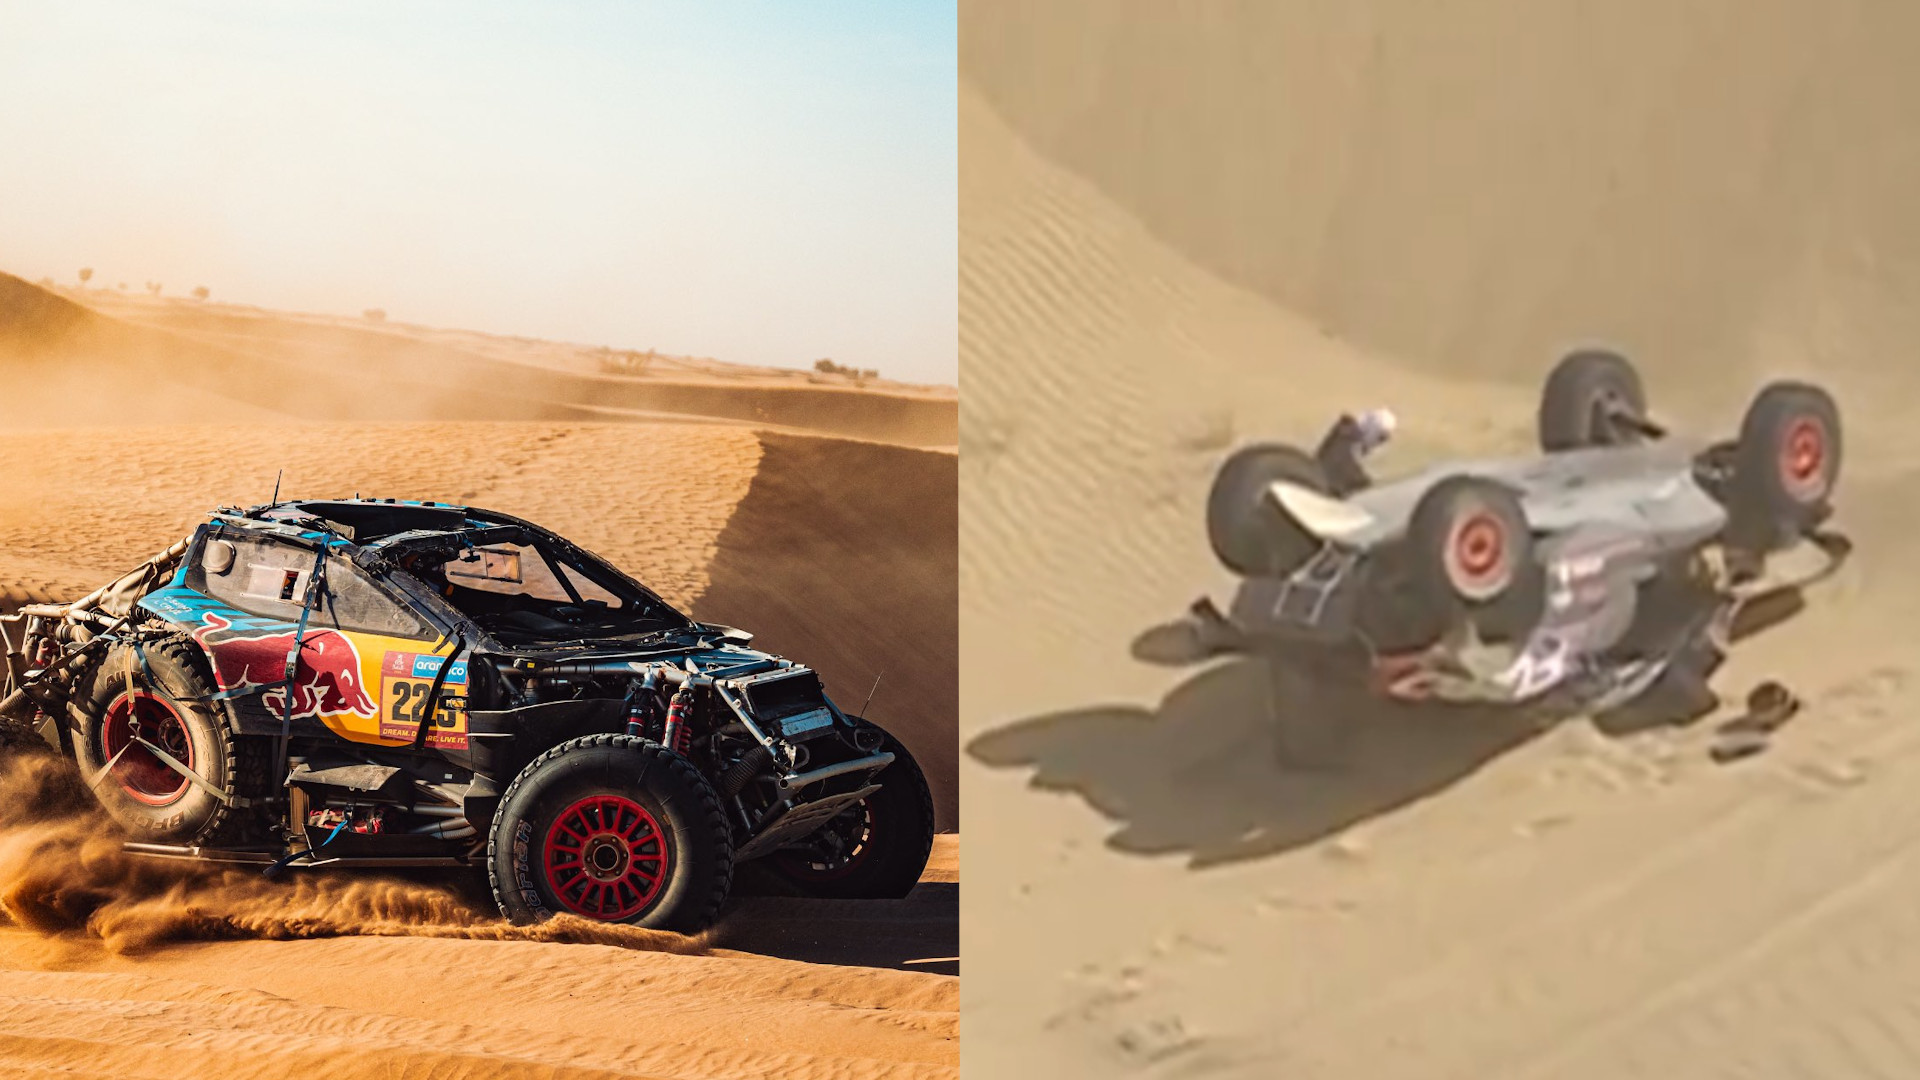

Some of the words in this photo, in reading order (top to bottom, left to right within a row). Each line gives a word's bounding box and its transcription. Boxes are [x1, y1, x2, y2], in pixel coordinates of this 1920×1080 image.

[392, 681, 456, 728] 225
[382, 728, 410, 737] DREAM.
[411, 731, 439, 742] DRE.
[440, 735, 456, 743] LIVE
